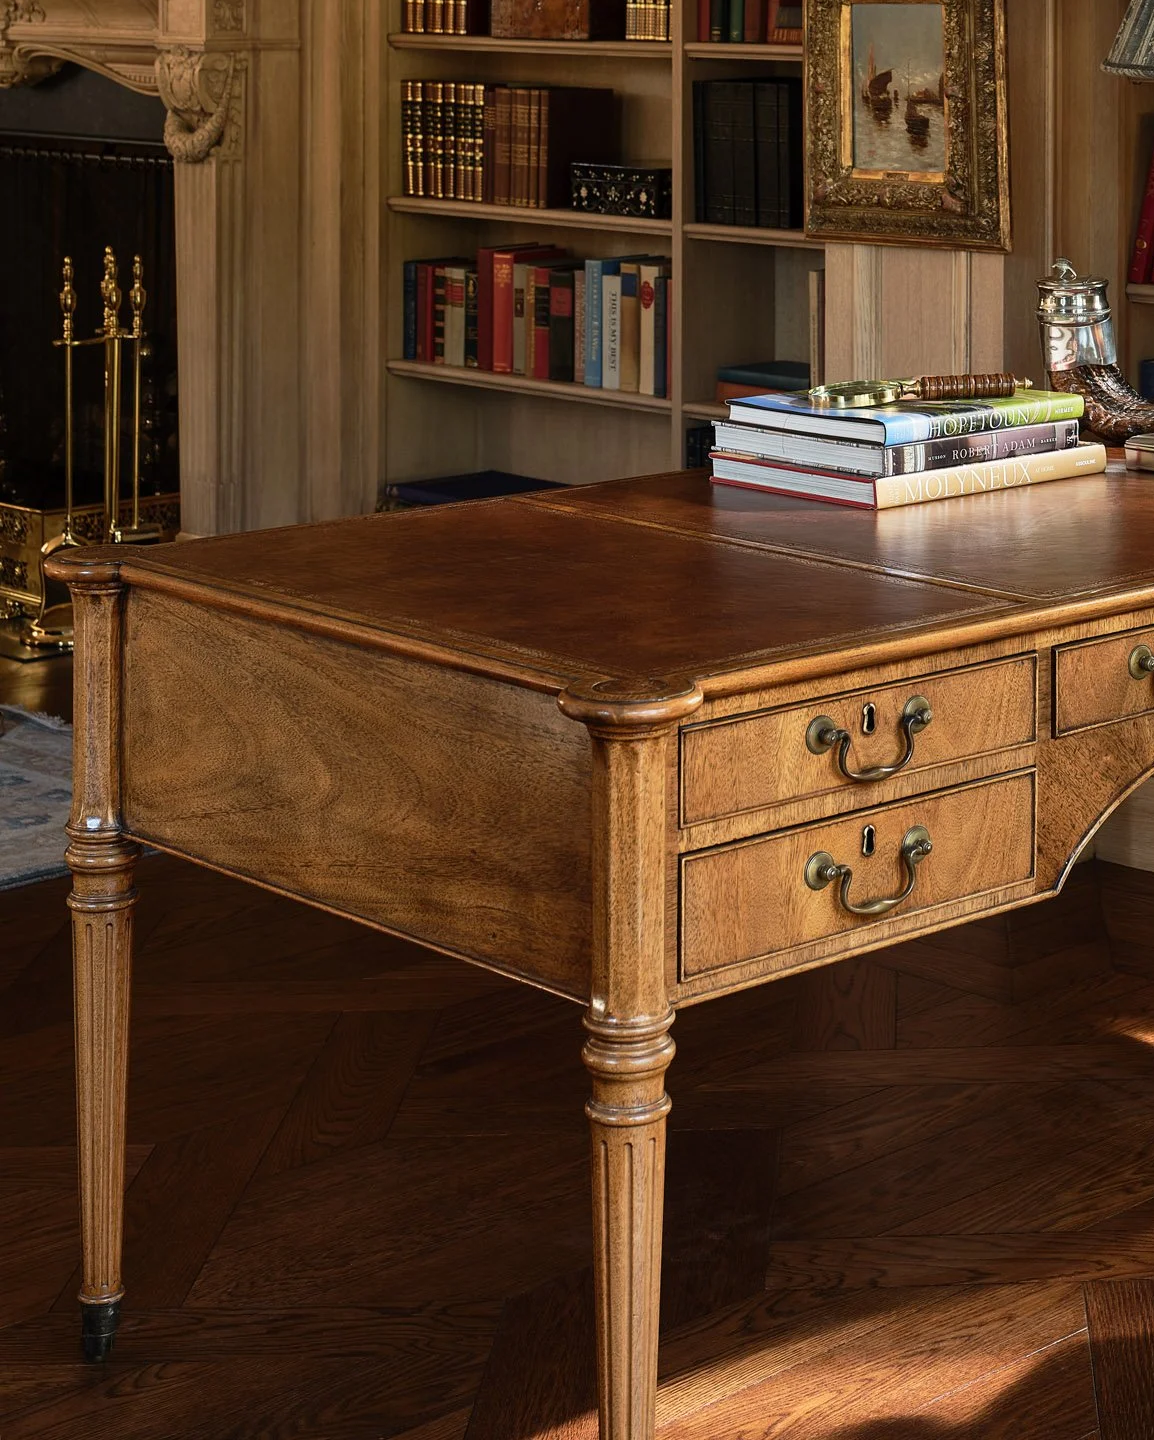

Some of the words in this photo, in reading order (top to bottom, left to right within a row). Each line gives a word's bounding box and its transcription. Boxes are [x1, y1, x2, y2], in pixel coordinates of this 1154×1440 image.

[611, 318, 618, 326] IS
[611, 328, 618, 346] MY
[929, 406, 1033, 438] HOPETOUN
[952, 445, 998, 460] ROBERT
[1002, 437, 1036, 452] ADAM
[904, 462, 1033, 504] MOLYNEUX
